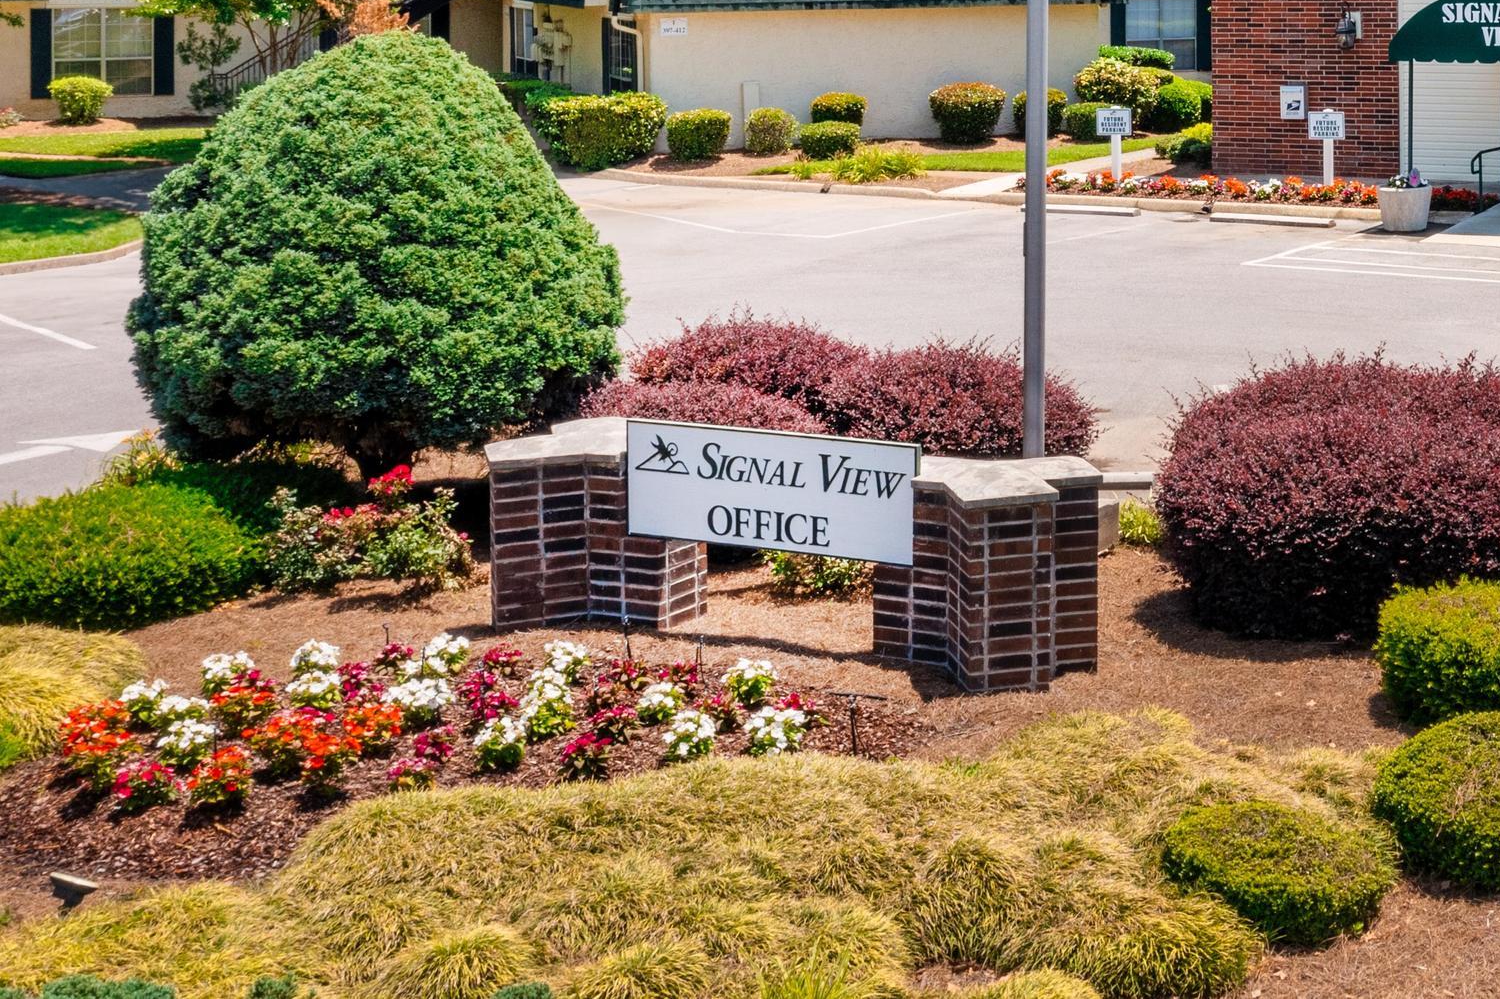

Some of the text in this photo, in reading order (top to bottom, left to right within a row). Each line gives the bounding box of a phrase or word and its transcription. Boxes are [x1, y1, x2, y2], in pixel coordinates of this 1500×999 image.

[697, 442, 907, 499] SIGNAL VIEW
[707, 504, 830, 547] OFFICE
